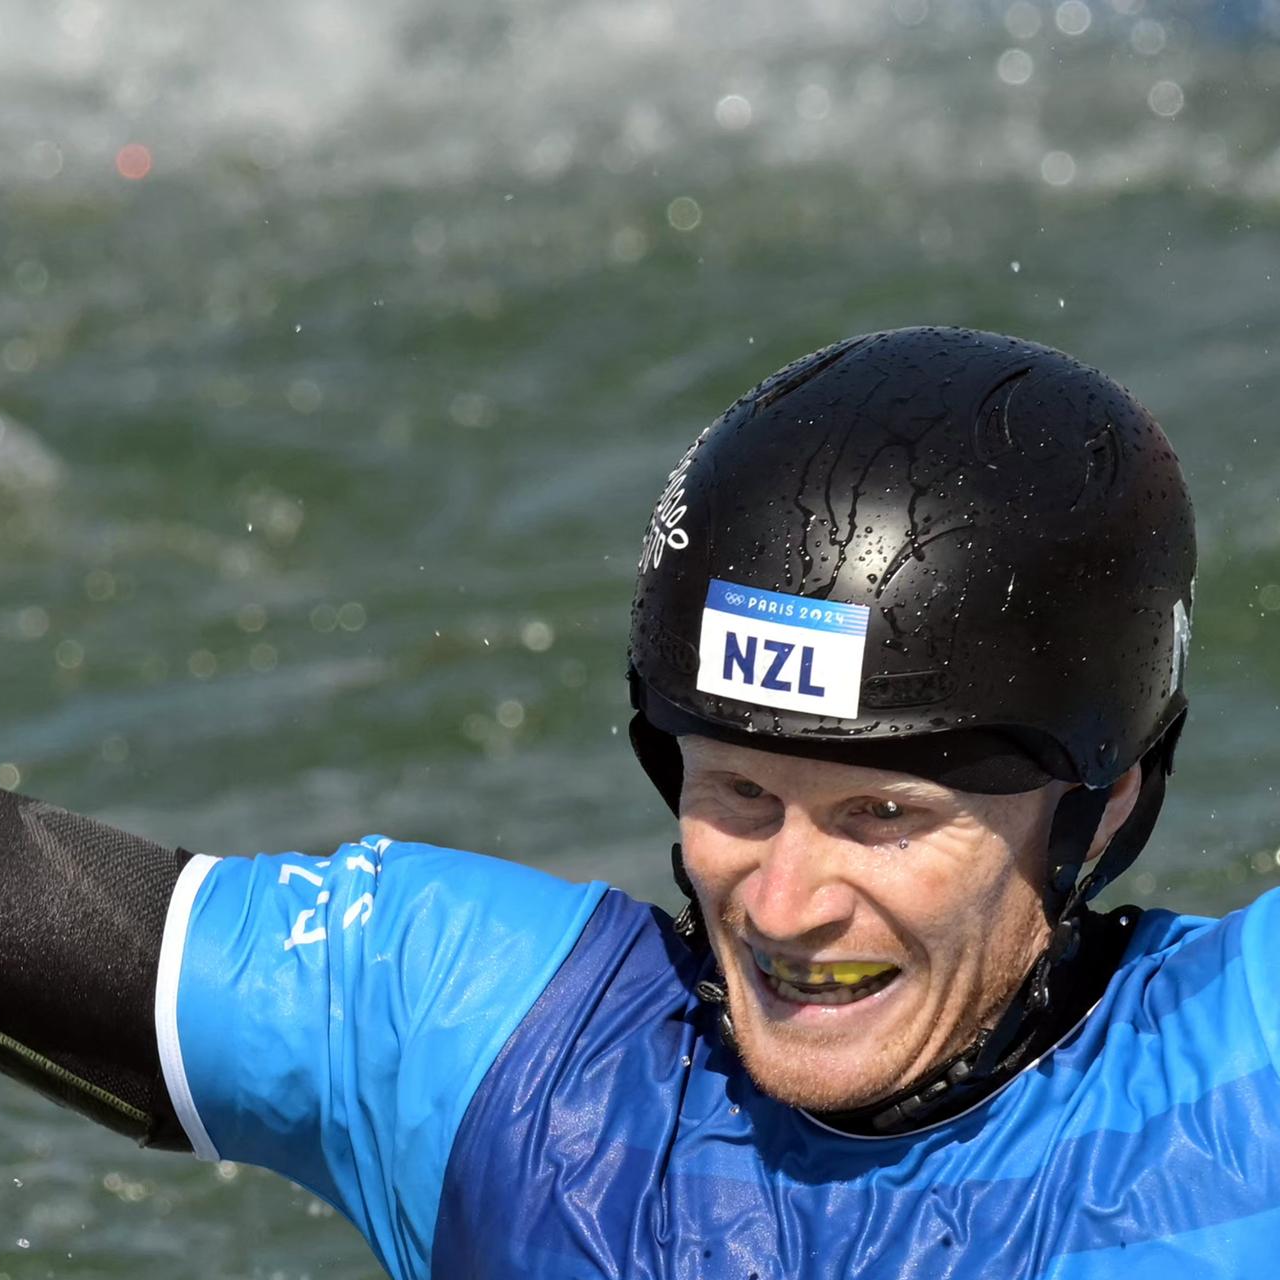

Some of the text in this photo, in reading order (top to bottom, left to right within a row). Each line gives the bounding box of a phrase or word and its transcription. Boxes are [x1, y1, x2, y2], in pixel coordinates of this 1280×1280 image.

[747, 597, 845, 624] PARIS 2024
[723, 631, 825, 697] NZL
